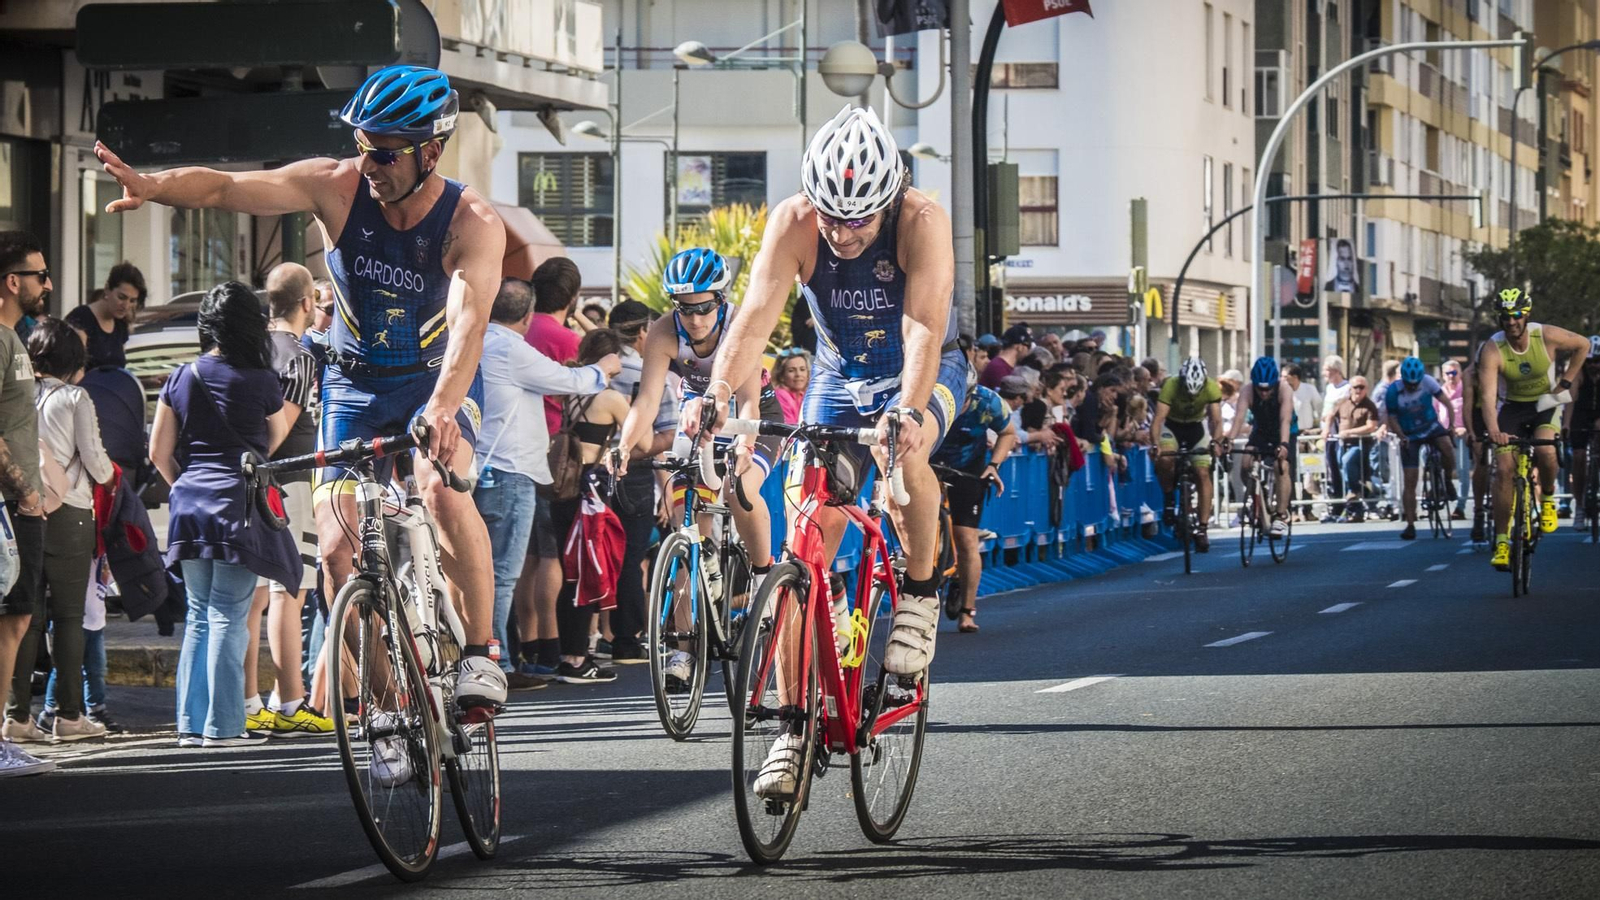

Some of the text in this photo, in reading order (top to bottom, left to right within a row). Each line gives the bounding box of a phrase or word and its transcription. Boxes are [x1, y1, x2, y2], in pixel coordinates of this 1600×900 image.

[354, 255, 424, 292] CARDOSO
[831, 289, 895, 311] MOGUEL
[691, 374, 710, 382] PEC
[423, 554, 433, 608] BICYCLE
